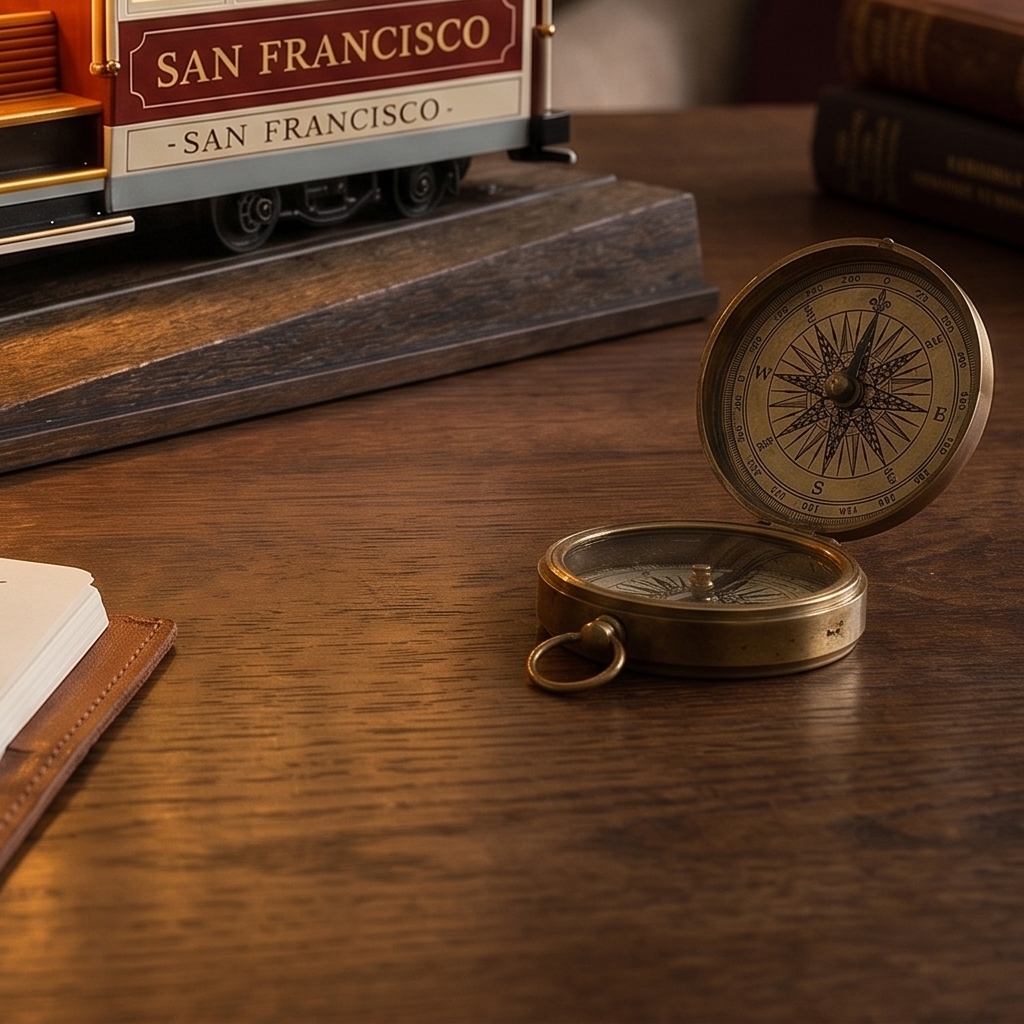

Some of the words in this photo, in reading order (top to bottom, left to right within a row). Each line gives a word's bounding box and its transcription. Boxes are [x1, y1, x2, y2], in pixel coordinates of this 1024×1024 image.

[157, 45, 243, 88] SAN
[259, 15, 490, 75] FRANCISCO
[754, 365, 773, 381] W
[811, 480, 824, 495] S
